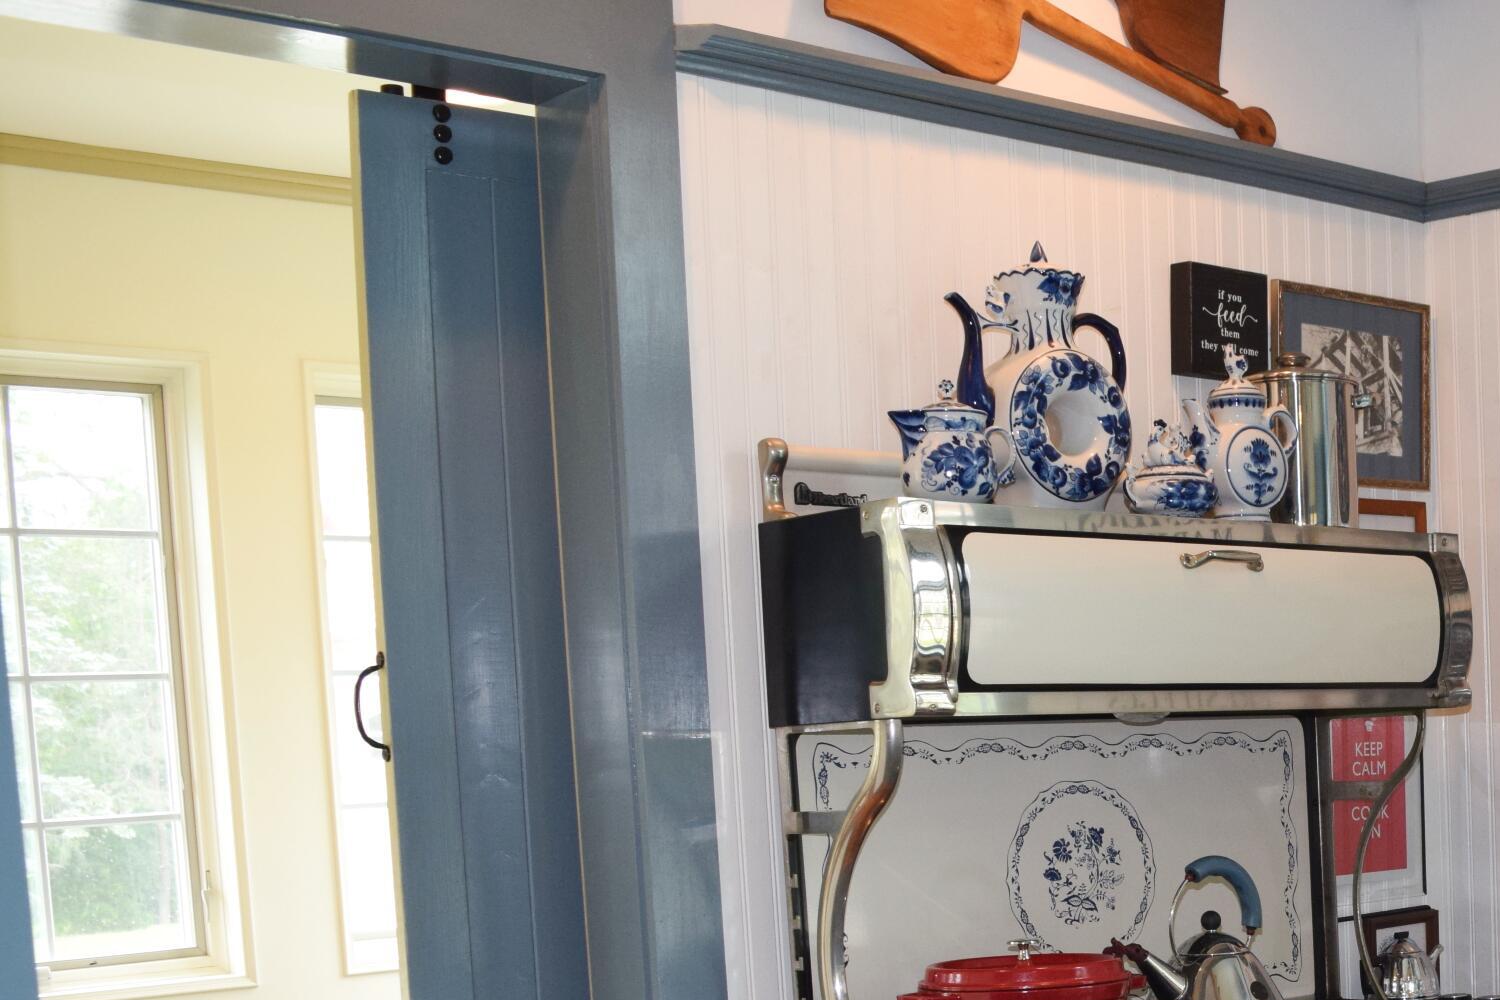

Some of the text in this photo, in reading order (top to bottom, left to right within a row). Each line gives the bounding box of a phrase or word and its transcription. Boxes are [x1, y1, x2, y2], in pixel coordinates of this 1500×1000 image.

[1218, 289, 1242, 303] if you
[1202, 302, 1258, 328] feed
[1220, 328, 1240, 339] them
[1201, 339, 1218, 352] they
[1239, 347, 1259, 357] come
[1355, 742, 1383, 757] KEEP
[1352, 760, 1386, 776] CALM
[1351, 804, 1389, 821] COK
